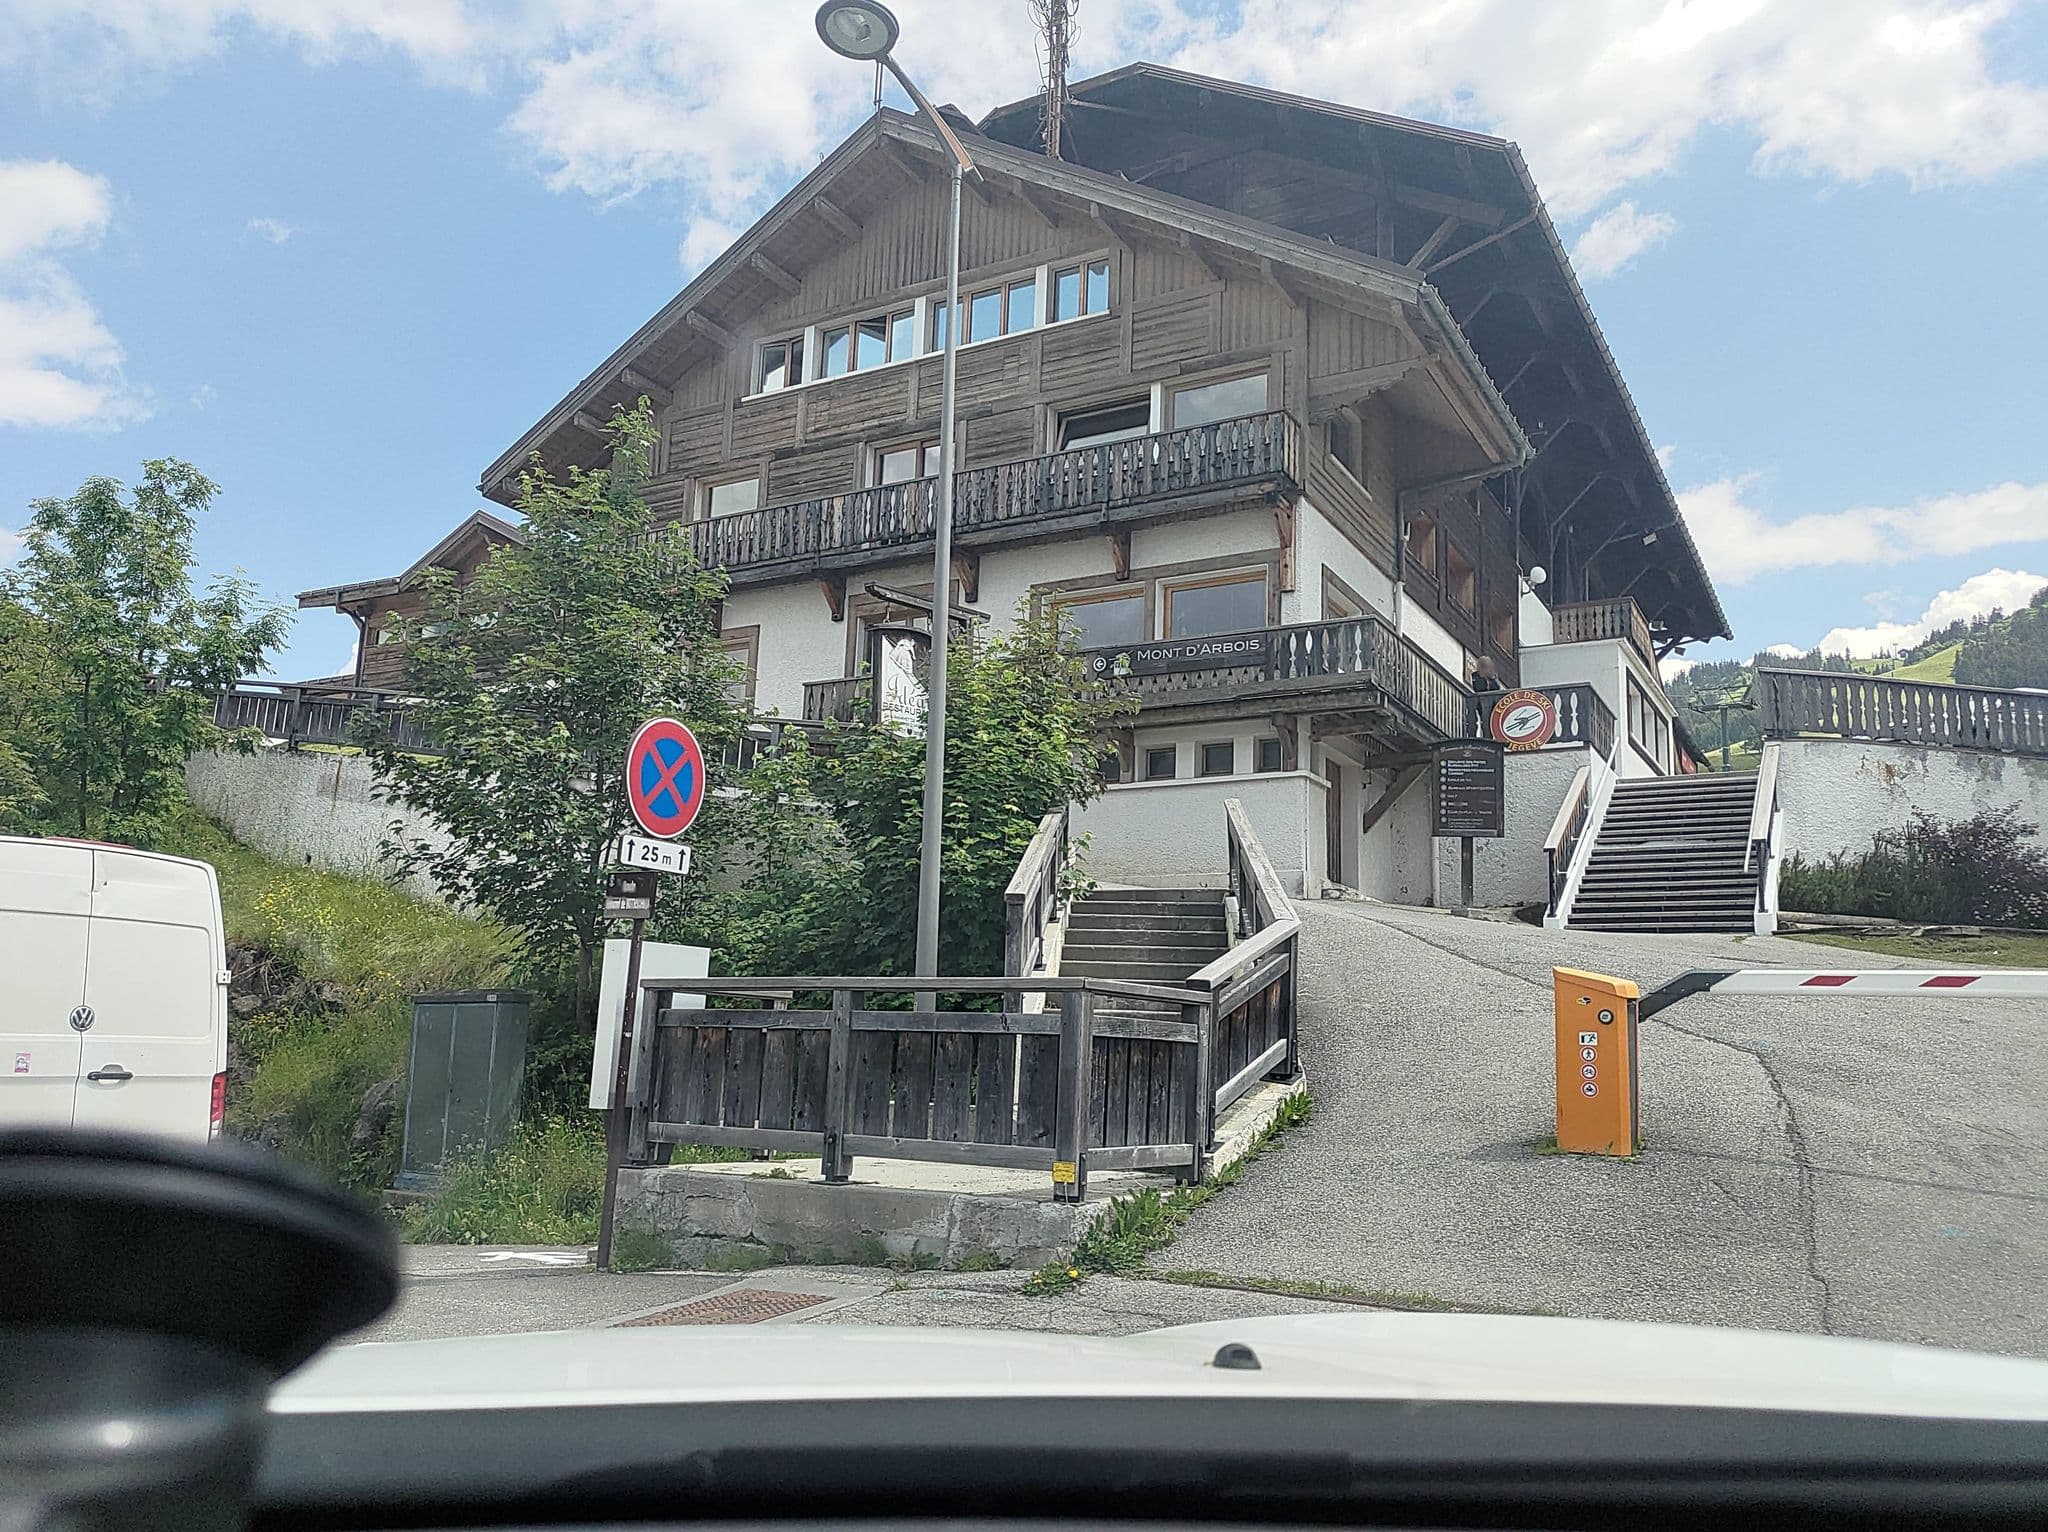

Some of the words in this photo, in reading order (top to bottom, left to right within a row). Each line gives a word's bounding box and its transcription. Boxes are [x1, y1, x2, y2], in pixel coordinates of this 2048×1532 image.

[1137, 648, 1182, 661] MONT
[1186, 640, 1260, 656] D'ARBOIS
[1496, 692, 1521, 714] ECOLE
[1523, 691, 1537, 700] DE
[1537, 696, 1552, 710] SKI
[641, 845, 659, 862] 25
[661, 855, 672, 865] m
